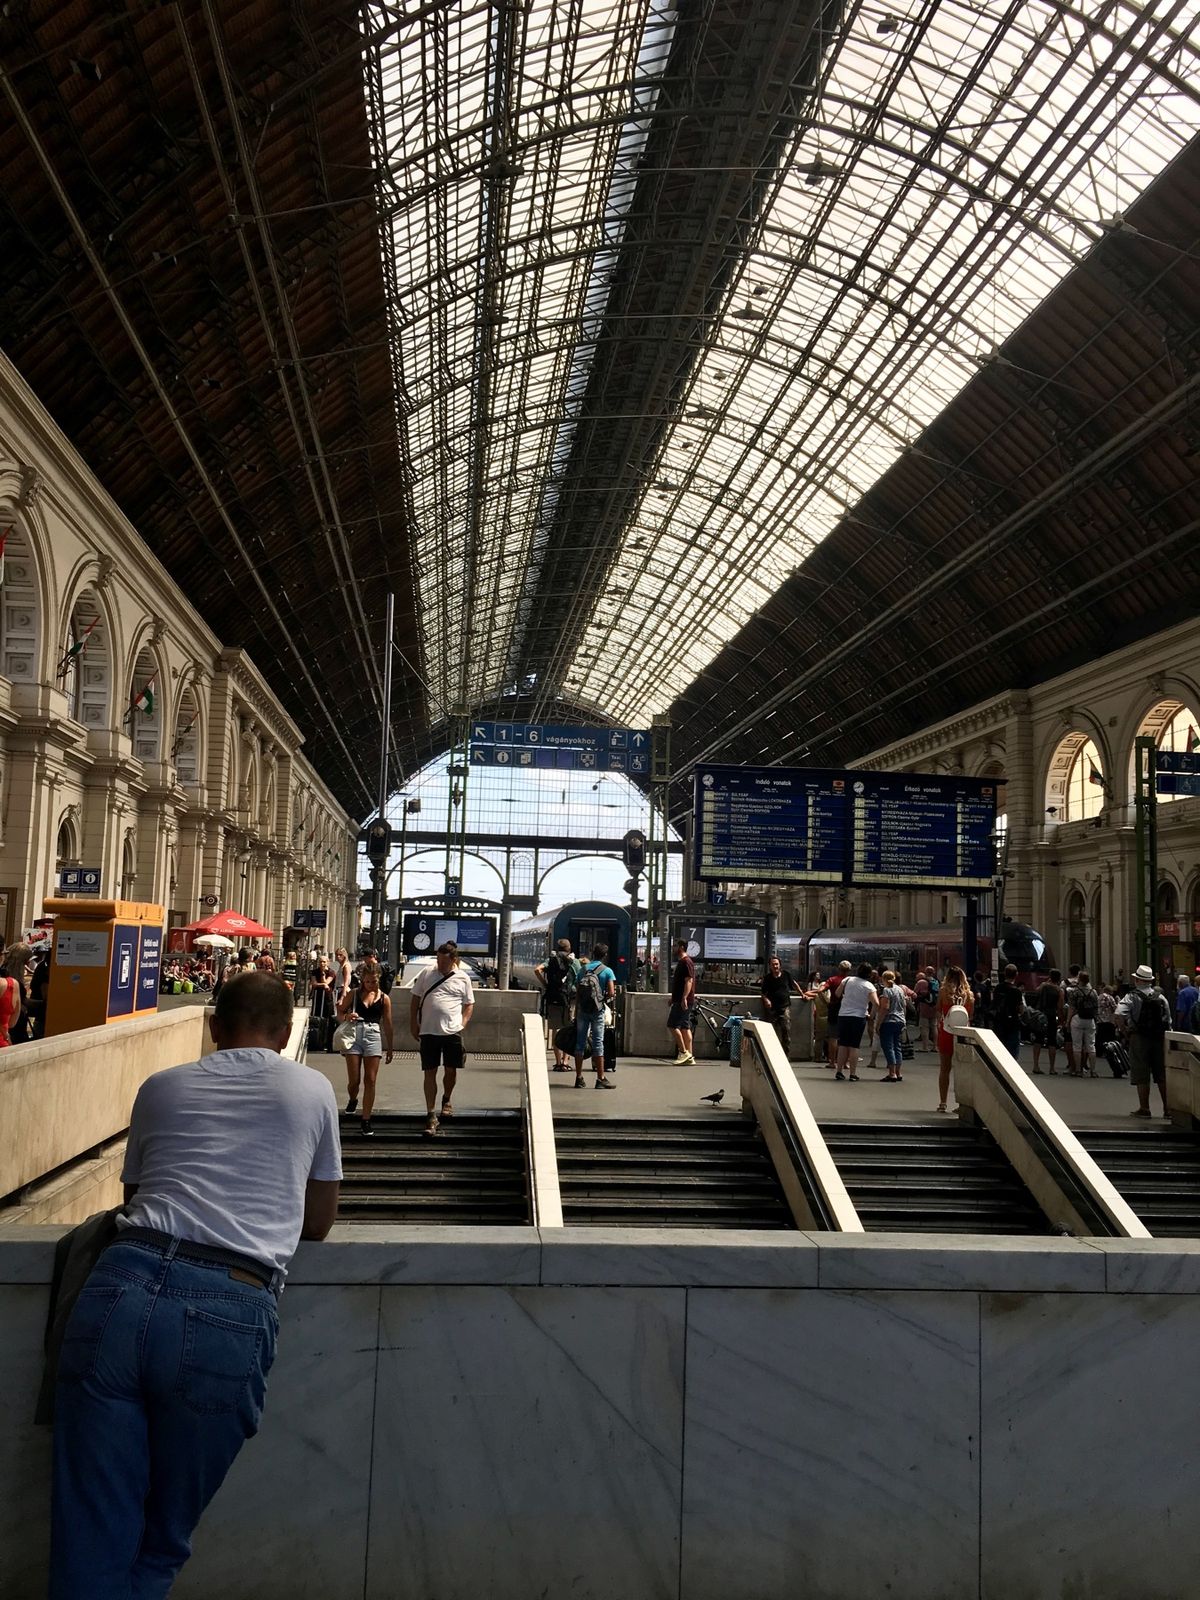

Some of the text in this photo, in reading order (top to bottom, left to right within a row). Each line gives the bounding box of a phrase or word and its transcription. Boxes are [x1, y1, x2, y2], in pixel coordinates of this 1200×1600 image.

[500, 729, 506, 740] 1
[529, 730, 538, 741] 6
[546, 736, 596, 746] vágányokhoz
[448, 886, 456, 895] 6
[716, 895, 723, 903] 7
[419, 920, 427, 931] 6
[689, 928, 697, 938] 7
